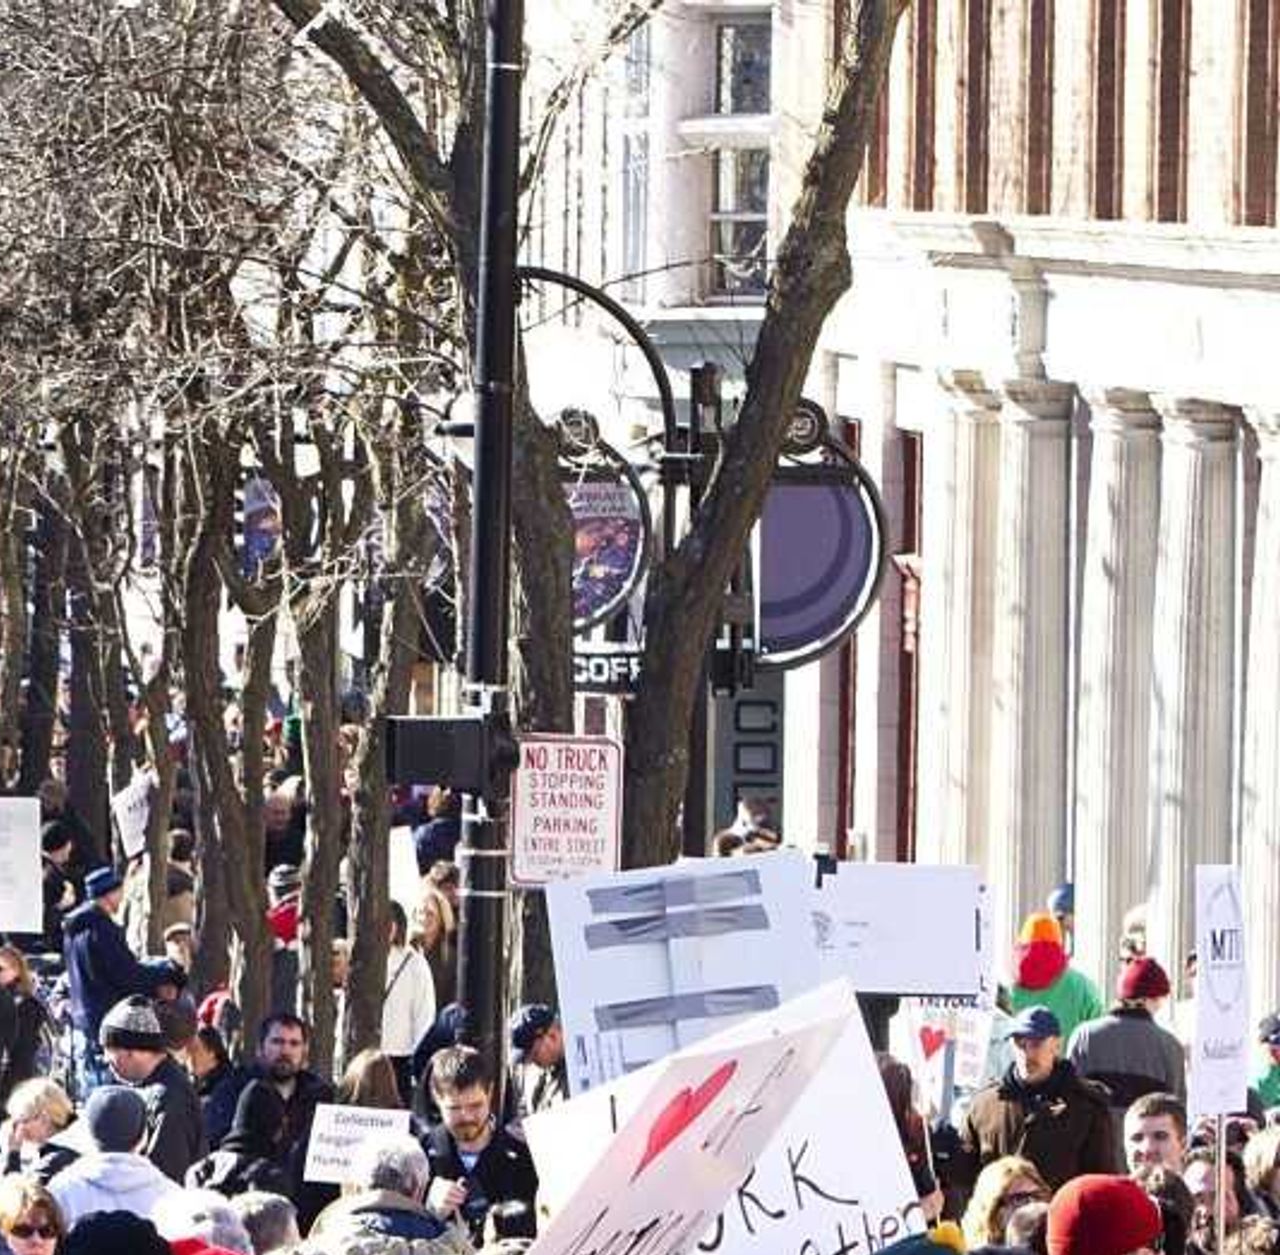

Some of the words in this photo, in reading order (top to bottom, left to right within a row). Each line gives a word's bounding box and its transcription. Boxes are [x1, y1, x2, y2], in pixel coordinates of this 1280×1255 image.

[525, 746, 548, 770] NO
[557, 746, 608, 772] TRUCK
[528, 771, 605, 791] STOPPING
[529, 791, 604, 810] STANDING
[532, 815, 598, 835] PARKING
